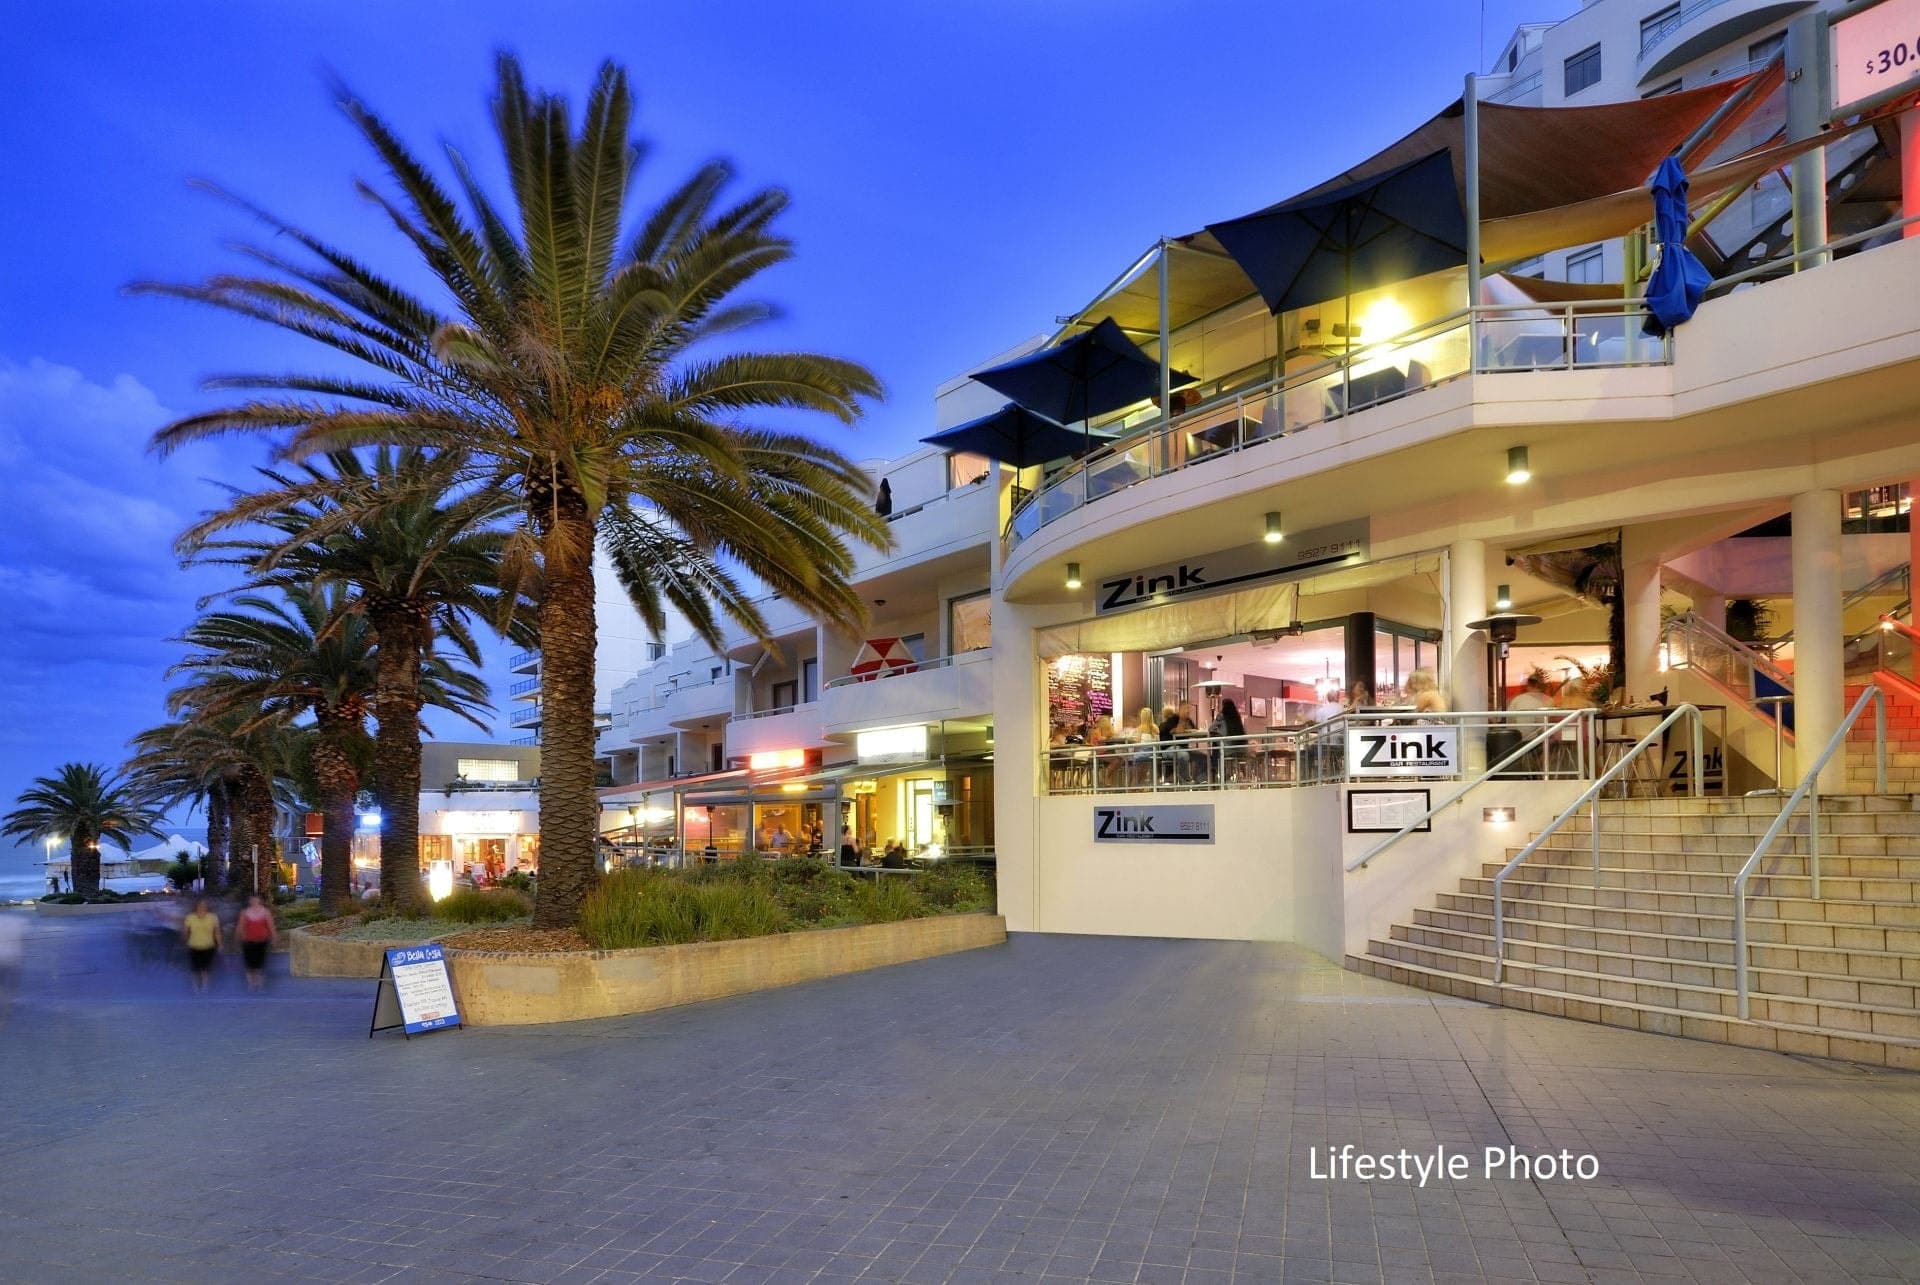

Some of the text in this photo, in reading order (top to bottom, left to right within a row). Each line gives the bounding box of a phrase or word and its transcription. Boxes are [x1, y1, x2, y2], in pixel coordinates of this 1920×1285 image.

[1866, 36, 1920, 75] $30.
[1102, 565, 1206, 610] Zink
[1360, 734, 1448, 768] Zink
[1097, 810, 1155, 838] Zink
